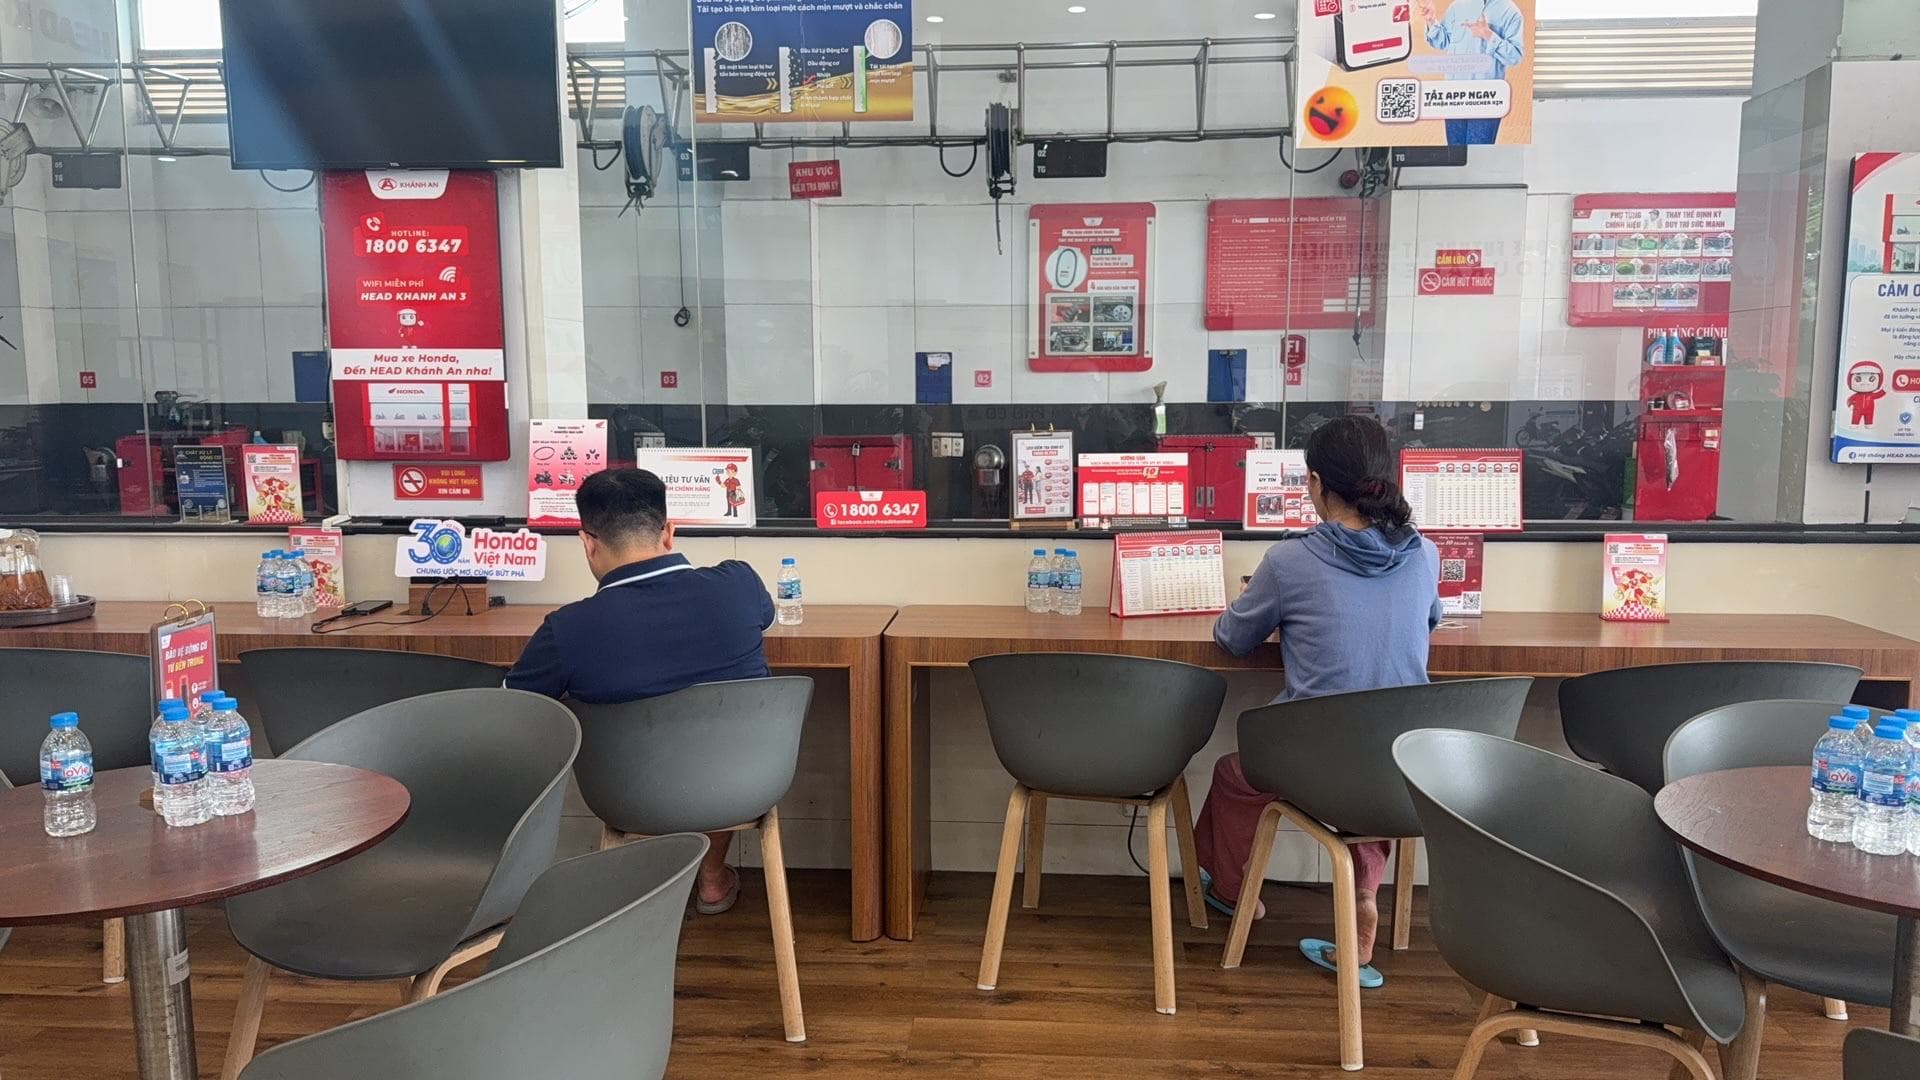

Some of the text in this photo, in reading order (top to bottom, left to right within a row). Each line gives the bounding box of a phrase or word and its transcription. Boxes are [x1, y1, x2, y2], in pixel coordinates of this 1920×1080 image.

[711, 6, 723, 14] tạo
[735, 5, 749, 13] mặt
[766, 4, 780, 12] loại
[782, 4, 796, 12] một
[817, 4, 831, 12] mịn
[833, 4, 853, 12] mượt
[1425, 89, 1497, 100] TẢI APP NGAY
[680, 152, 690, 161] 03
[795, 165, 834, 178] KHU VỰC
[1037, 165, 1046, 174] TG
[400, 180, 427, 188] KHÁNH
[1610, 209, 1641, 220] PHỤ TÙNG
[1667, 211, 1681, 219] THAY
[1683, 208, 1695, 219] THẾ
[1696, 210, 1712, 220] ĐỊNH
[1665, 220, 1678, 229] DUY
[391, 230, 430, 238] HOTLINE:
[365, 239, 462, 254] 1800 6347
[1437, 251, 1452, 265] CẤM
[362, 276, 424, 288] WIFI MIỄN PHÍ
[1441, 272, 1494, 287] CẤM HÚT THUỐC
[1878, 280, 1909, 297] CẢM
[361, 292, 467, 301] HEAD KHANH AN 3
[1696, 324, 1728, 338] CHÍNH
[374, 353, 460, 365] Mua xe Honda,
[343, 364, 493, 376] Đến HEAD Khánh An nha!
[82, 375, 94, 385] 05
[663, 375, 675, 384] 03
[977, 374, 990, 384] 02
[682, 475, 693, 483] TƯ
[695, 473, 710, 484] VẤN
[841, 503, 920, 517] 1800 6347
[474, 532, 538, 551] Honda
[474, 552, 537, 568] Việt Nam
[416, 567, 442, 575] CHUNG
[474, 567, 494, 577] CÙNG
[495, 568, 510, 577] BỨT
[511, 568, 526, 578] PHÁ
[166, 648, 177, 660] BẢO
